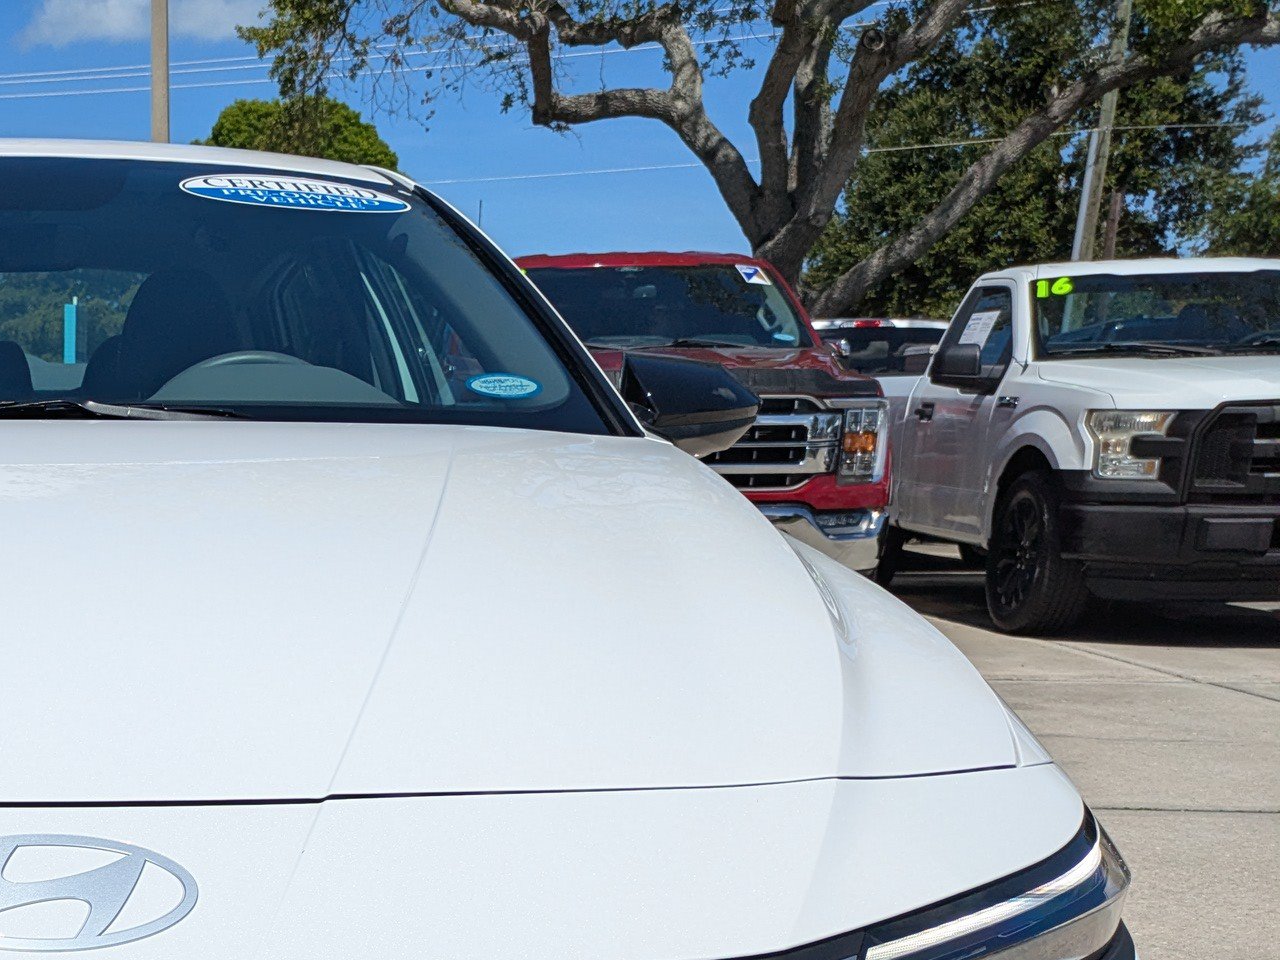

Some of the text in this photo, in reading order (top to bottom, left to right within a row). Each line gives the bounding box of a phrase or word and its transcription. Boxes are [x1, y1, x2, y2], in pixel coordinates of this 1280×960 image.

[203, 178, 378, 199] CERTIFIED
[221, 188, 380, 206] PRE-OWNED
[250, 195, 365, 210] VEHICLE
[1036, 277, 1073, 298] 16
